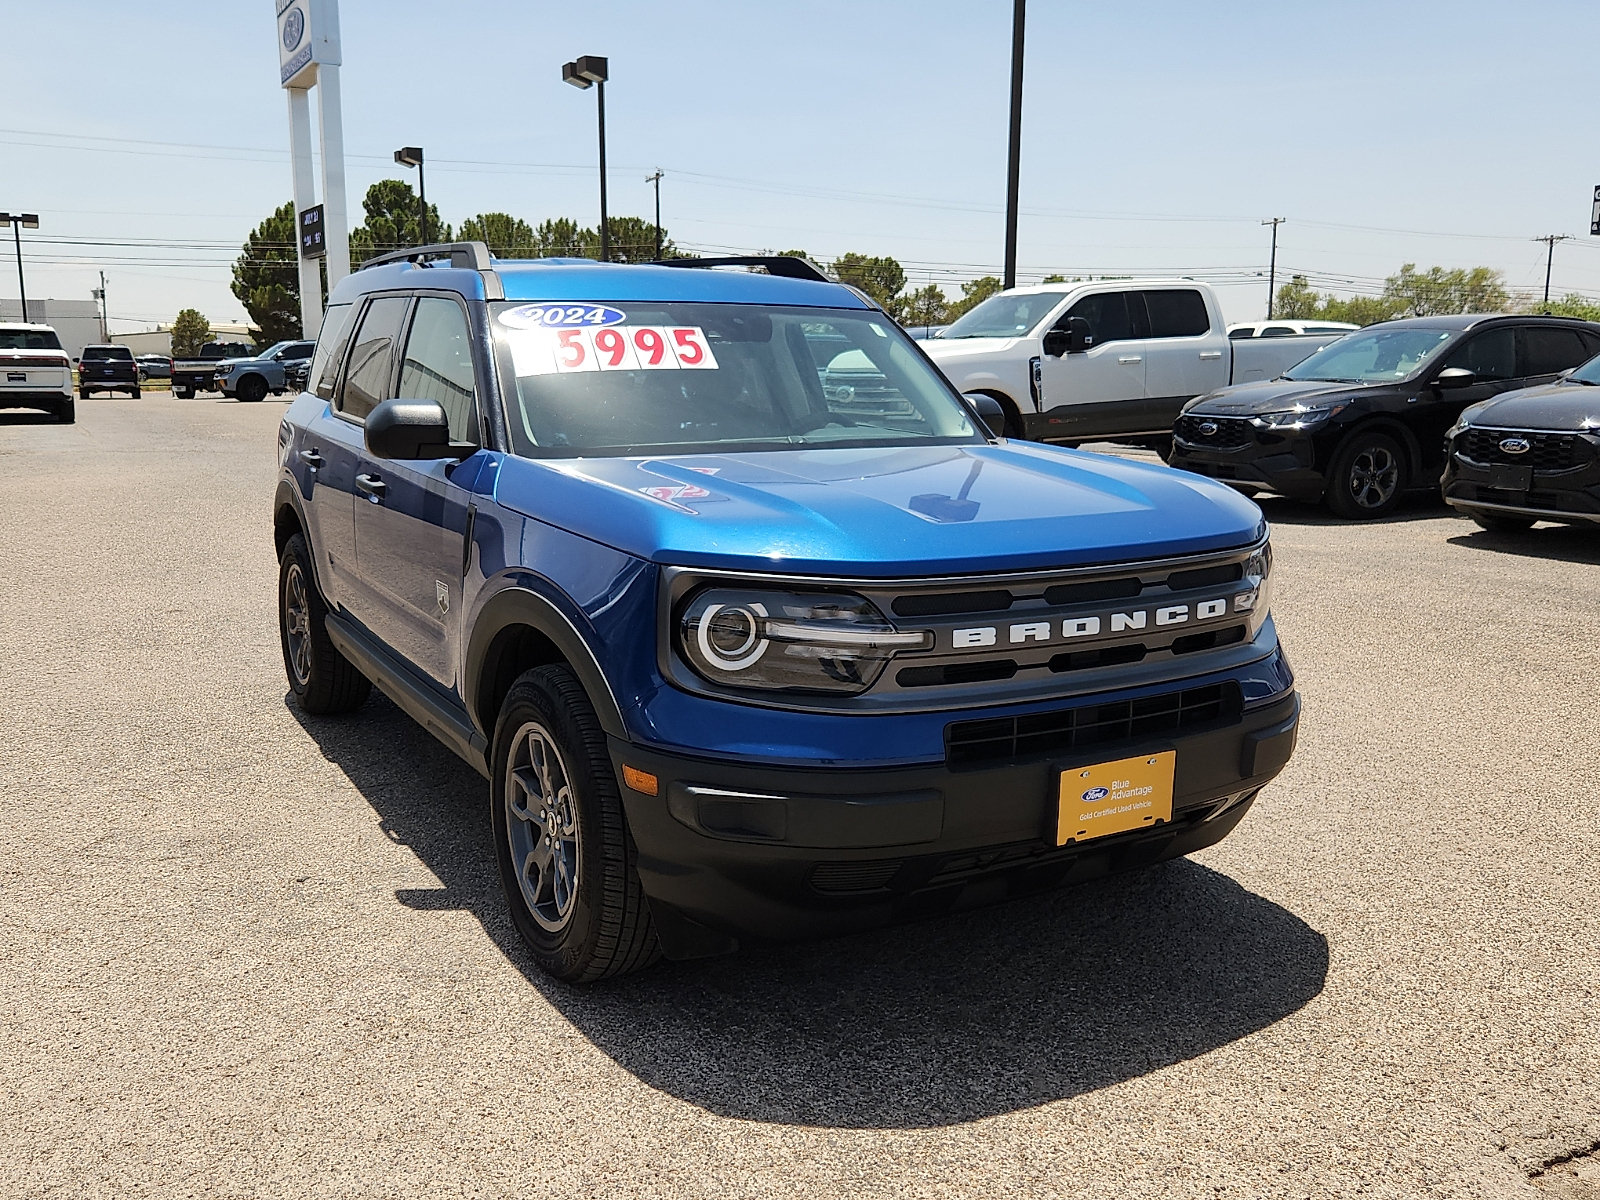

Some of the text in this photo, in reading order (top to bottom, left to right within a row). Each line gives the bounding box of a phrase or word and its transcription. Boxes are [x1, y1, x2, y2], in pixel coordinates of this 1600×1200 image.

[521, 307, 607, 325] 2024
[952, 598, 1226, 649] BRONCO
[1111, 780, 1130, 791] Blue
[1111, 785, 1153, 801] Advantage
[1079, 800, 1152, 821] Gold Certified Used Vehicle
